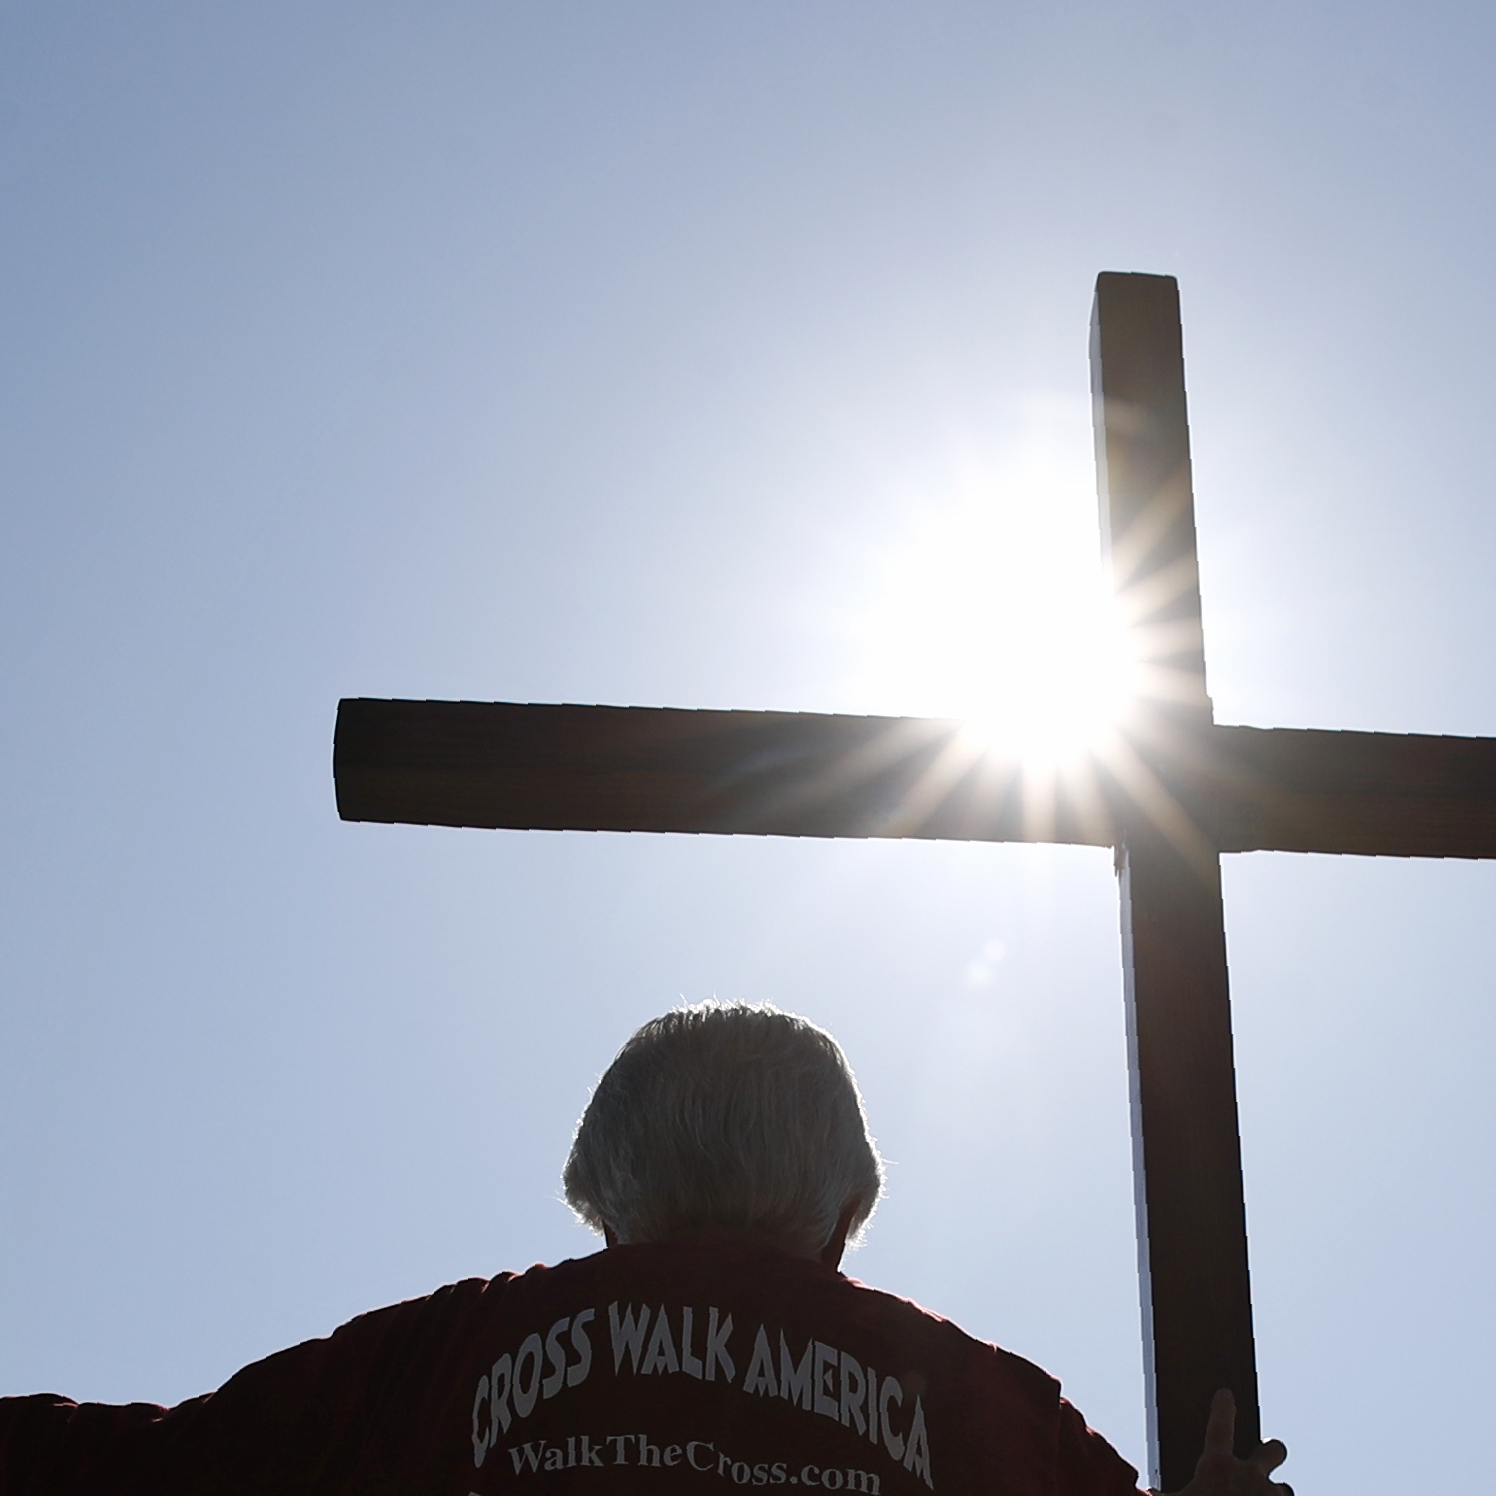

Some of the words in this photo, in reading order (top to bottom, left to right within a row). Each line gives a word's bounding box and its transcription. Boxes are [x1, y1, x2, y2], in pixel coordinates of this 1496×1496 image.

[471, 1308, 596, 1468] CROSS
[608, 1300, 736, 1384] WALK
[743, 1323, 935, 1491] AMERICA
[507, 1433, 882, 1496] WalkTheCross.com
